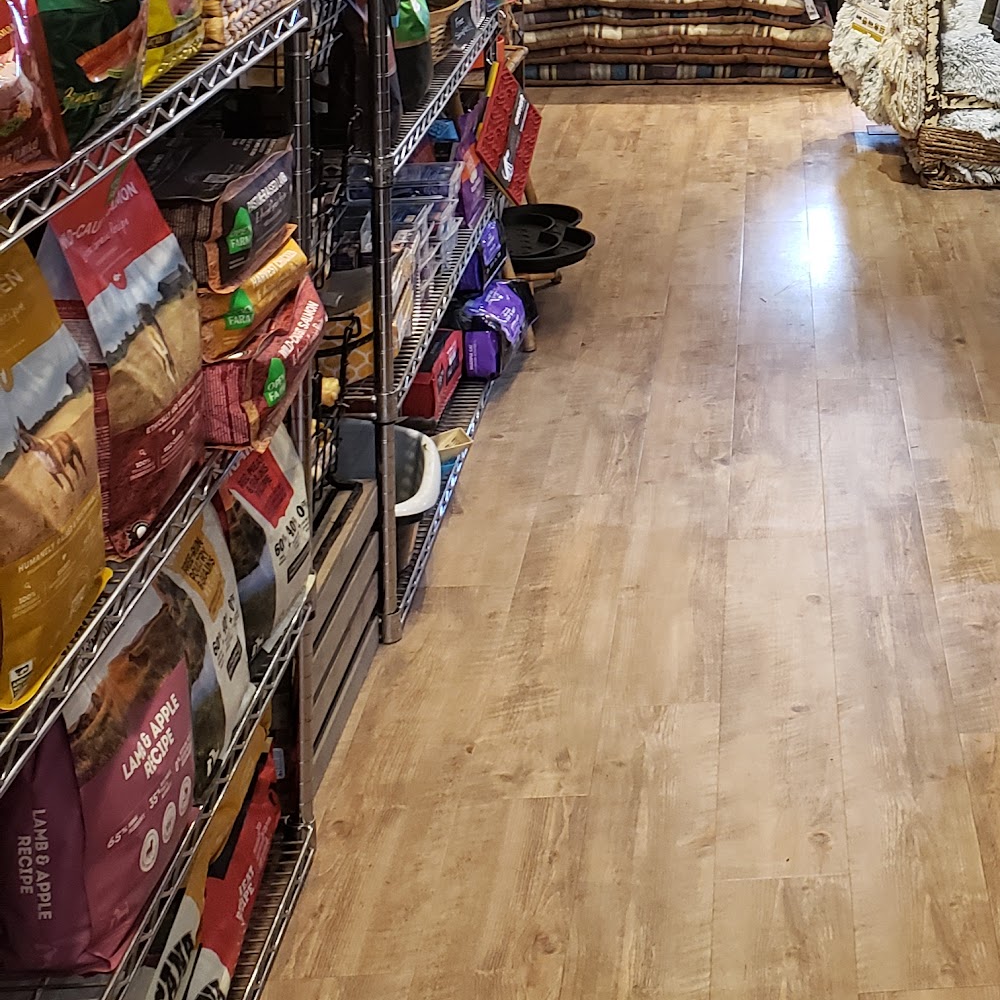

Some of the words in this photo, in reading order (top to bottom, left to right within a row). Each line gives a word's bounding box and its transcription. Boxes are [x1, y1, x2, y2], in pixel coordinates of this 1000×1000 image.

[298, 300, 320, 332] SALMON
[140, 731, 153, 749] &
[149, 693, 180, 740] APPLE
[31, 808, 48, 851] LAMB
[17, 834, 34, 895] RECIPE
[33, 851, 49, 868] &
[35, 868, 53, 920] APPLE
